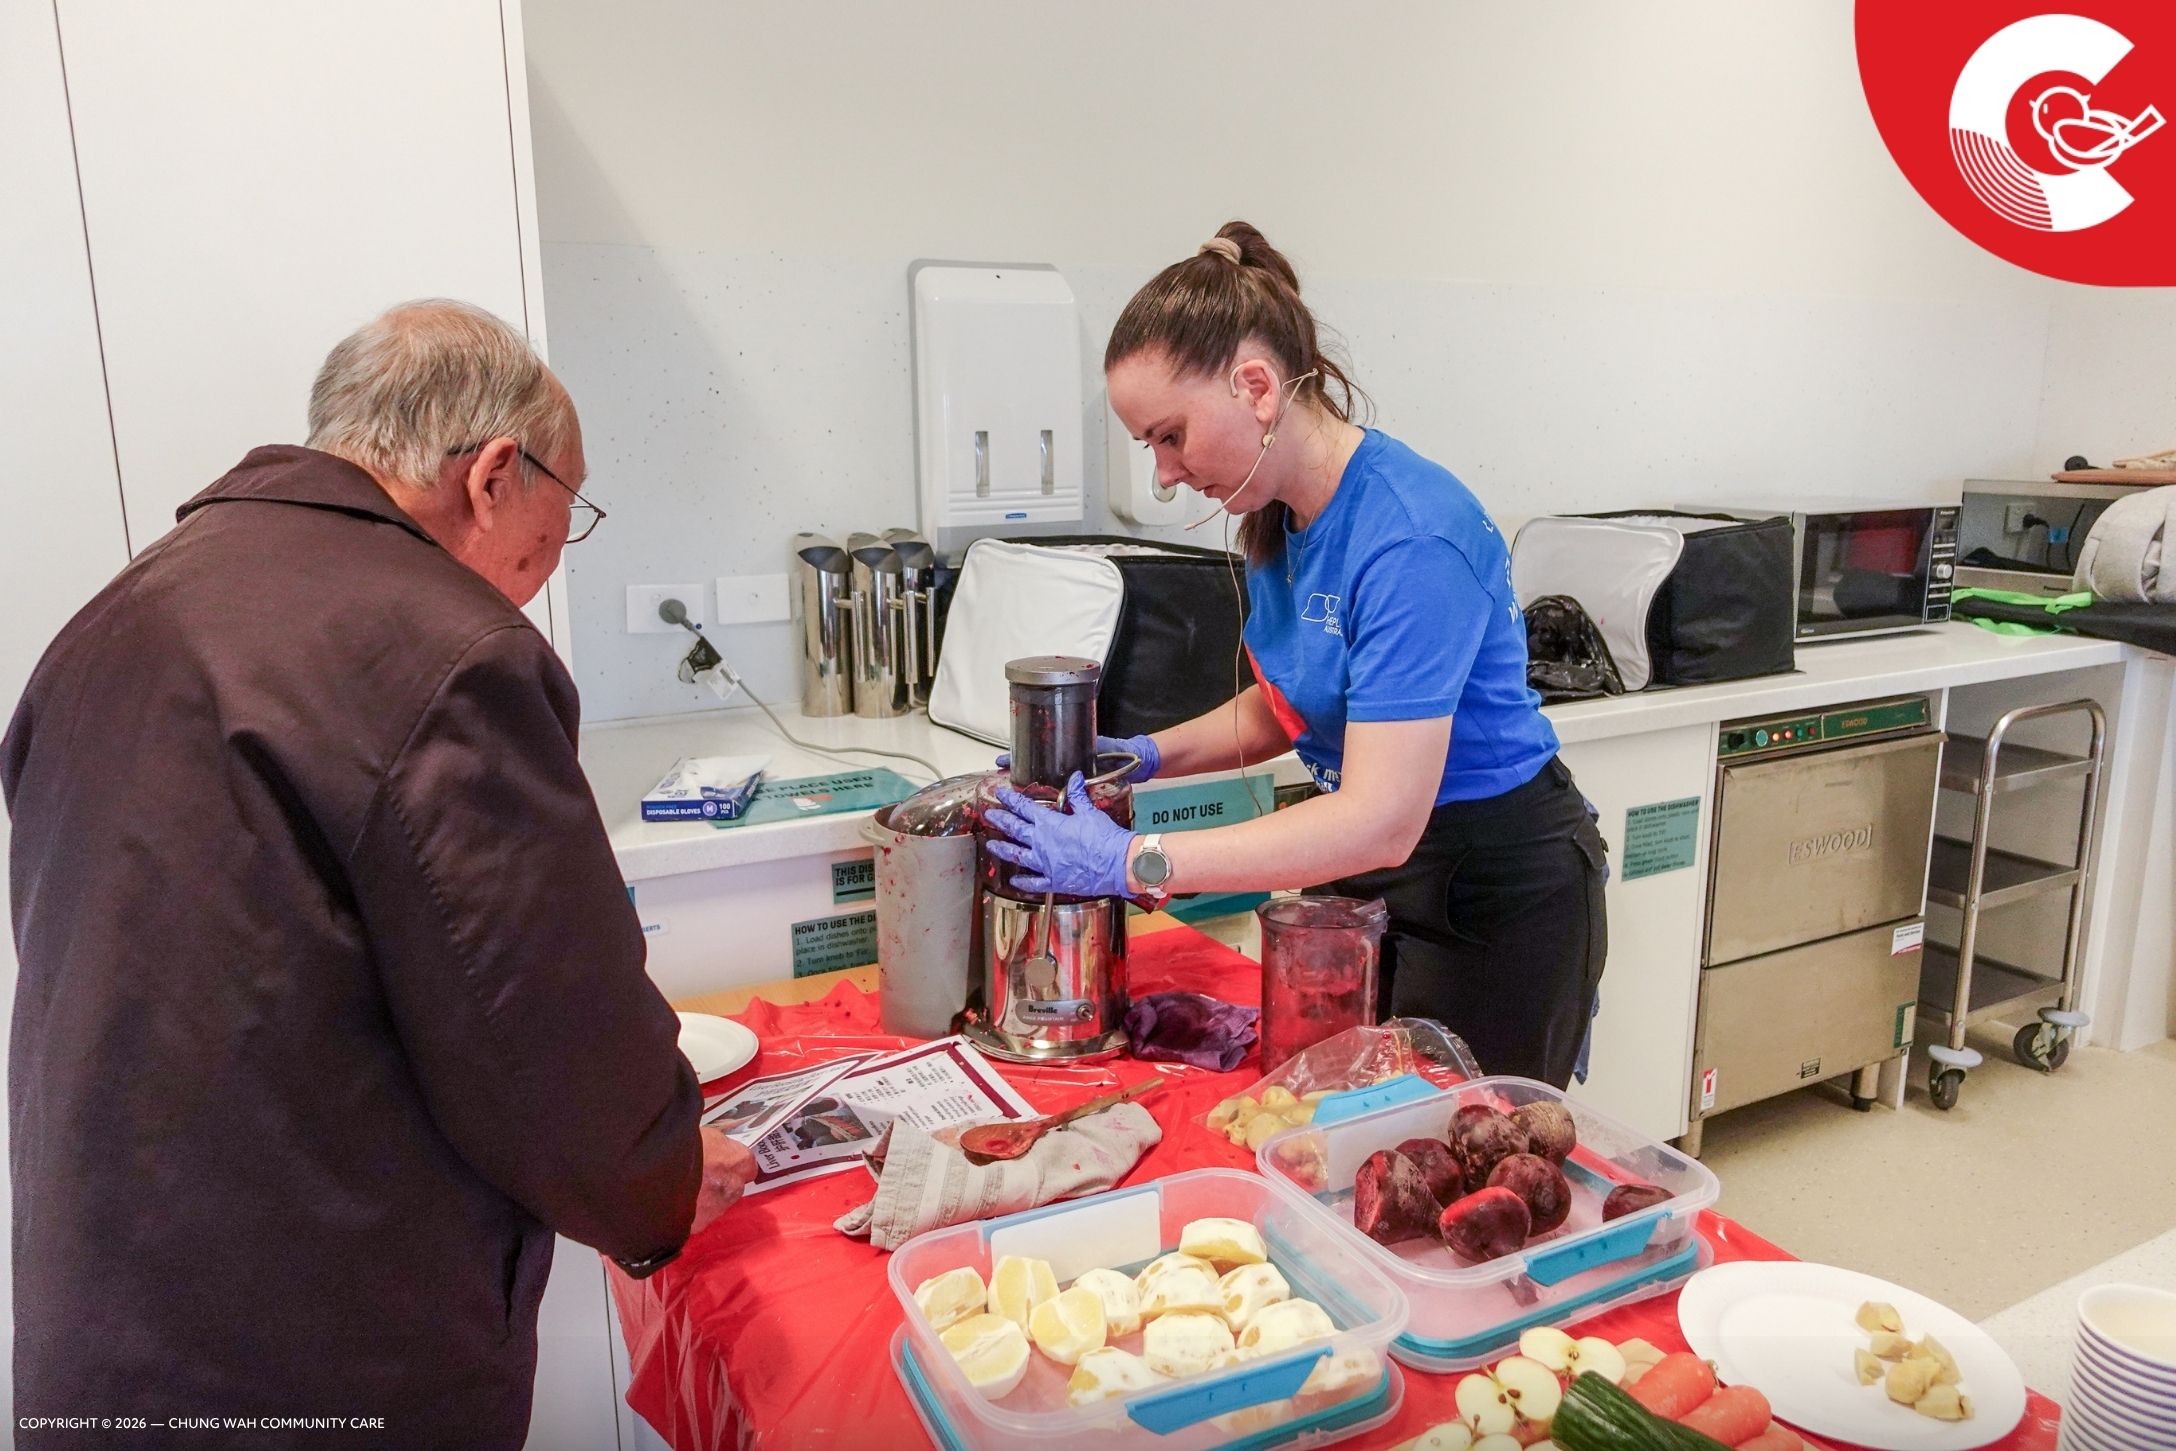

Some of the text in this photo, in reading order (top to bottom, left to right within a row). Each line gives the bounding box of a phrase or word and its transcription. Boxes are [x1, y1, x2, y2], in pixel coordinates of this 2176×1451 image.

[831, 775, 873, 785] USED
[832, 782, 874, 792] HERE
[646, 808, 680, 816] DISPOSABLE
[706, 805, 714, 813] M
[1152, 802, 1224, 825] DO NOT USE
[835, 866, 856, 877] THIS
[836, 877, 845, 886] IS
[847, 875, 865, 884] FOR
[795, 924, 815, 935] HOW
[817, 921, 829, 931] TO
[830, 918, 847, 929] USE
[850, 915, 865, 926] THE
[1028, 1004, 1058, 1014] Breville
